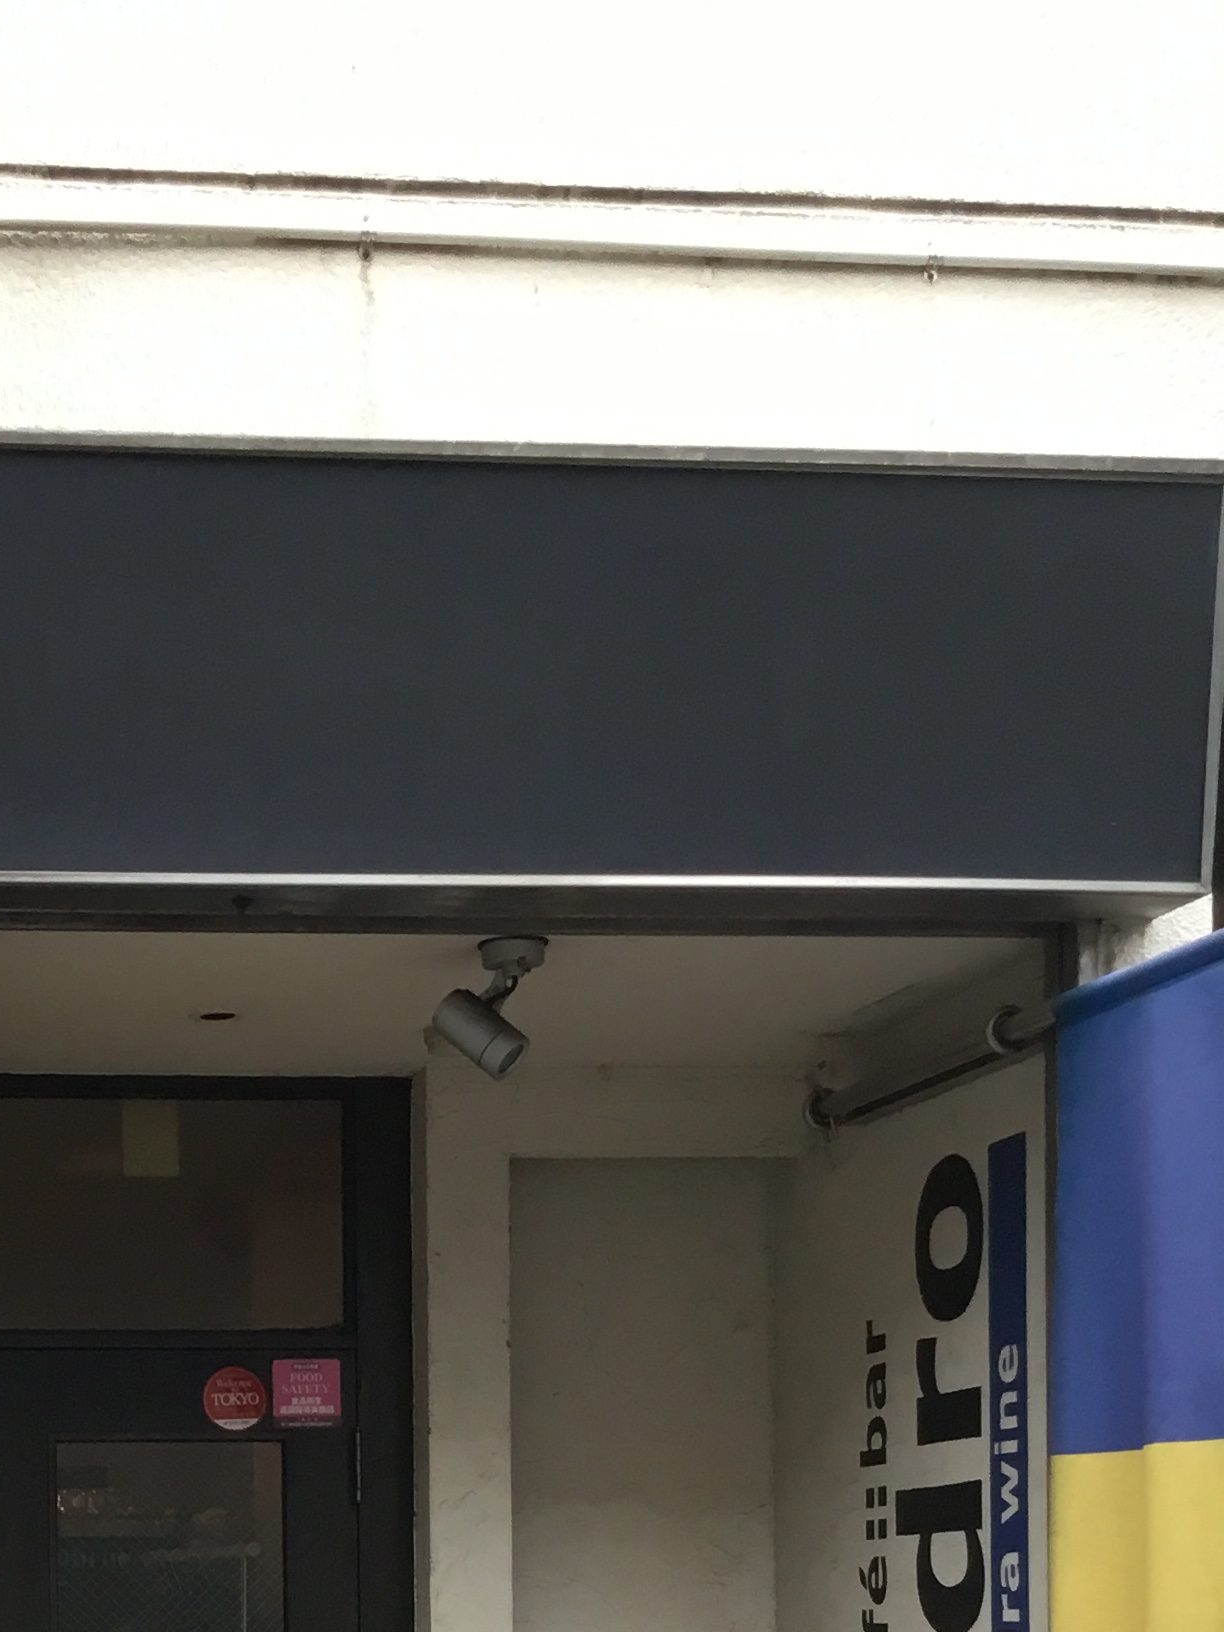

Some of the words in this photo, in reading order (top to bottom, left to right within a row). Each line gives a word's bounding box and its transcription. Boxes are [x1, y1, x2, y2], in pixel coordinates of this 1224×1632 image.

[211, 1392, 259, 1406] TOKYO
[860, 1320, 888, 1467] bar
[994, 1344, 1020, 1524] wine
